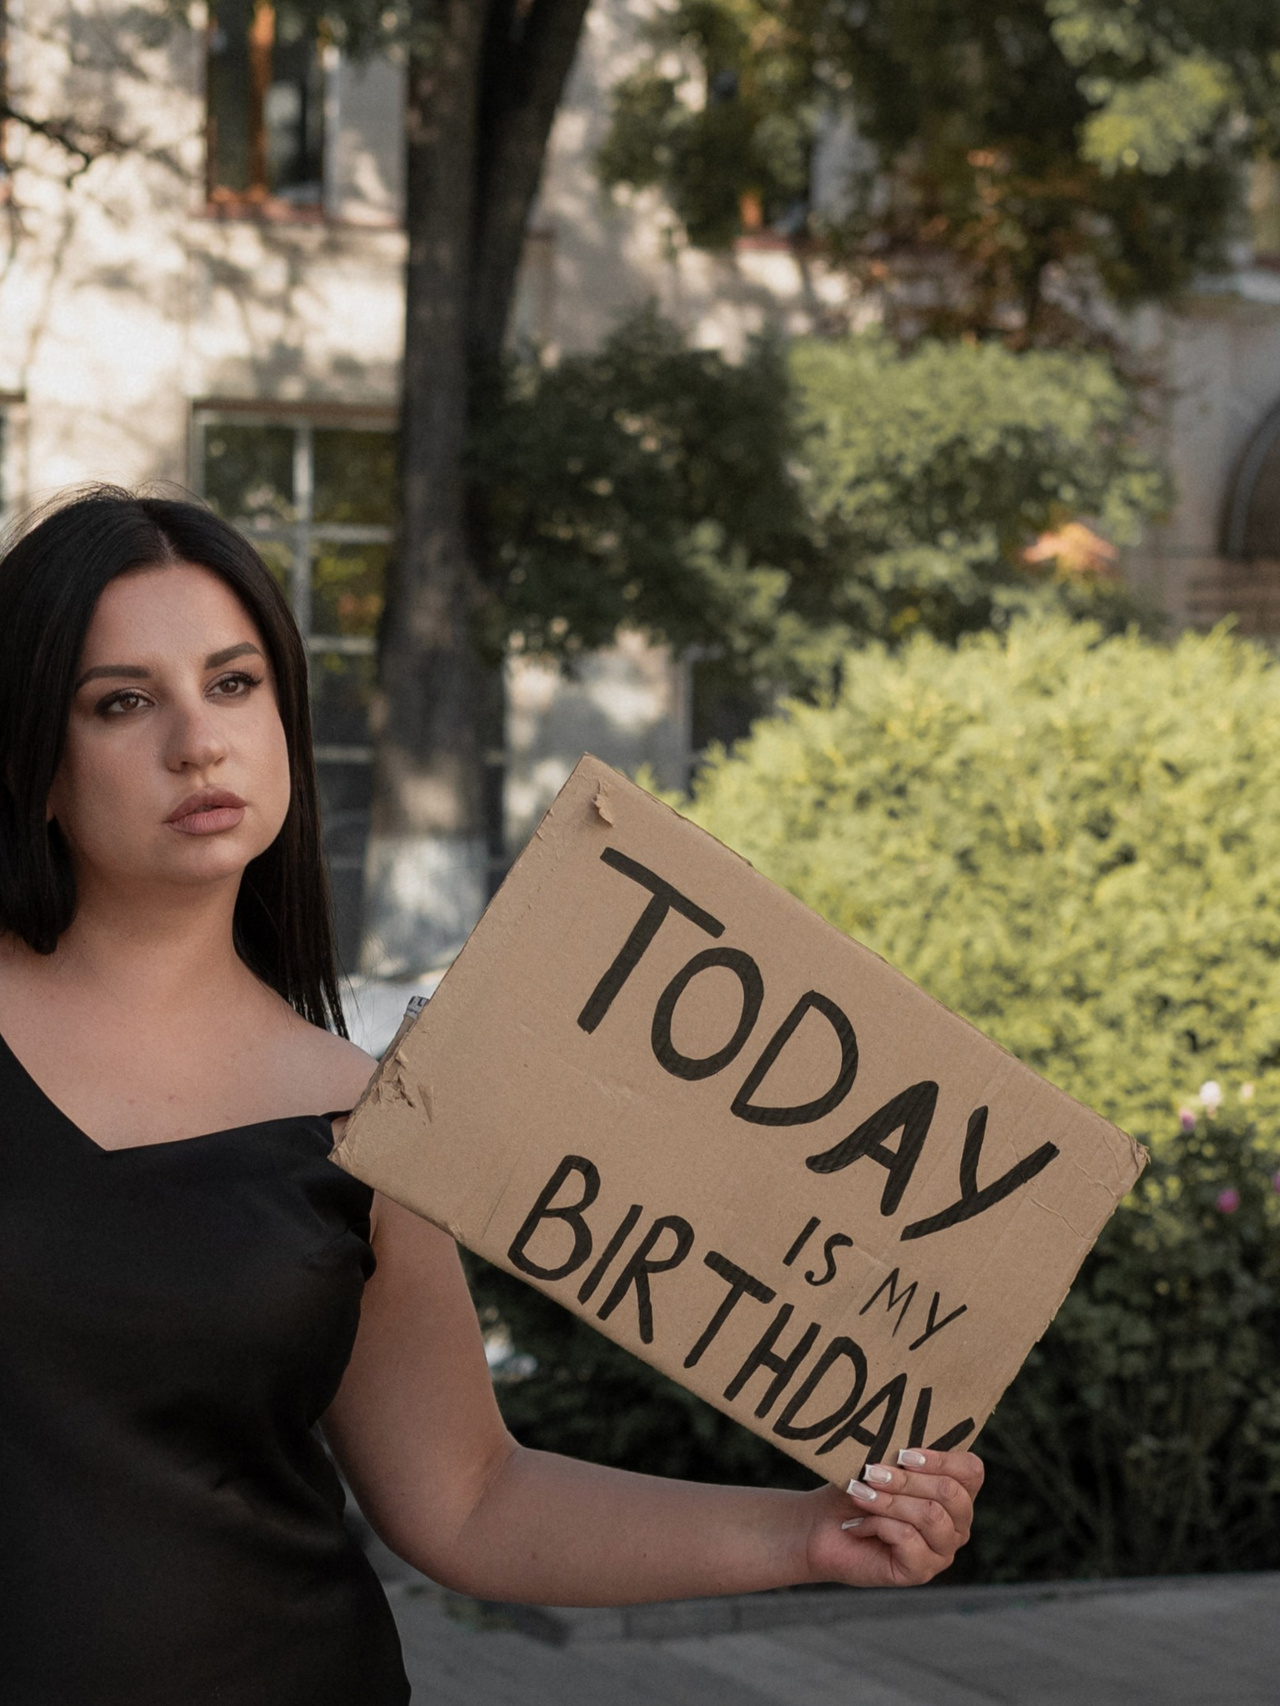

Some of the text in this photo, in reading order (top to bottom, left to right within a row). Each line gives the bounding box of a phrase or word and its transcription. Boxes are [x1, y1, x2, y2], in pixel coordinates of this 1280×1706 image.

[577, 846, 1060, 1241] TODAY
[783, 1217, 968, 1351] IS MY
